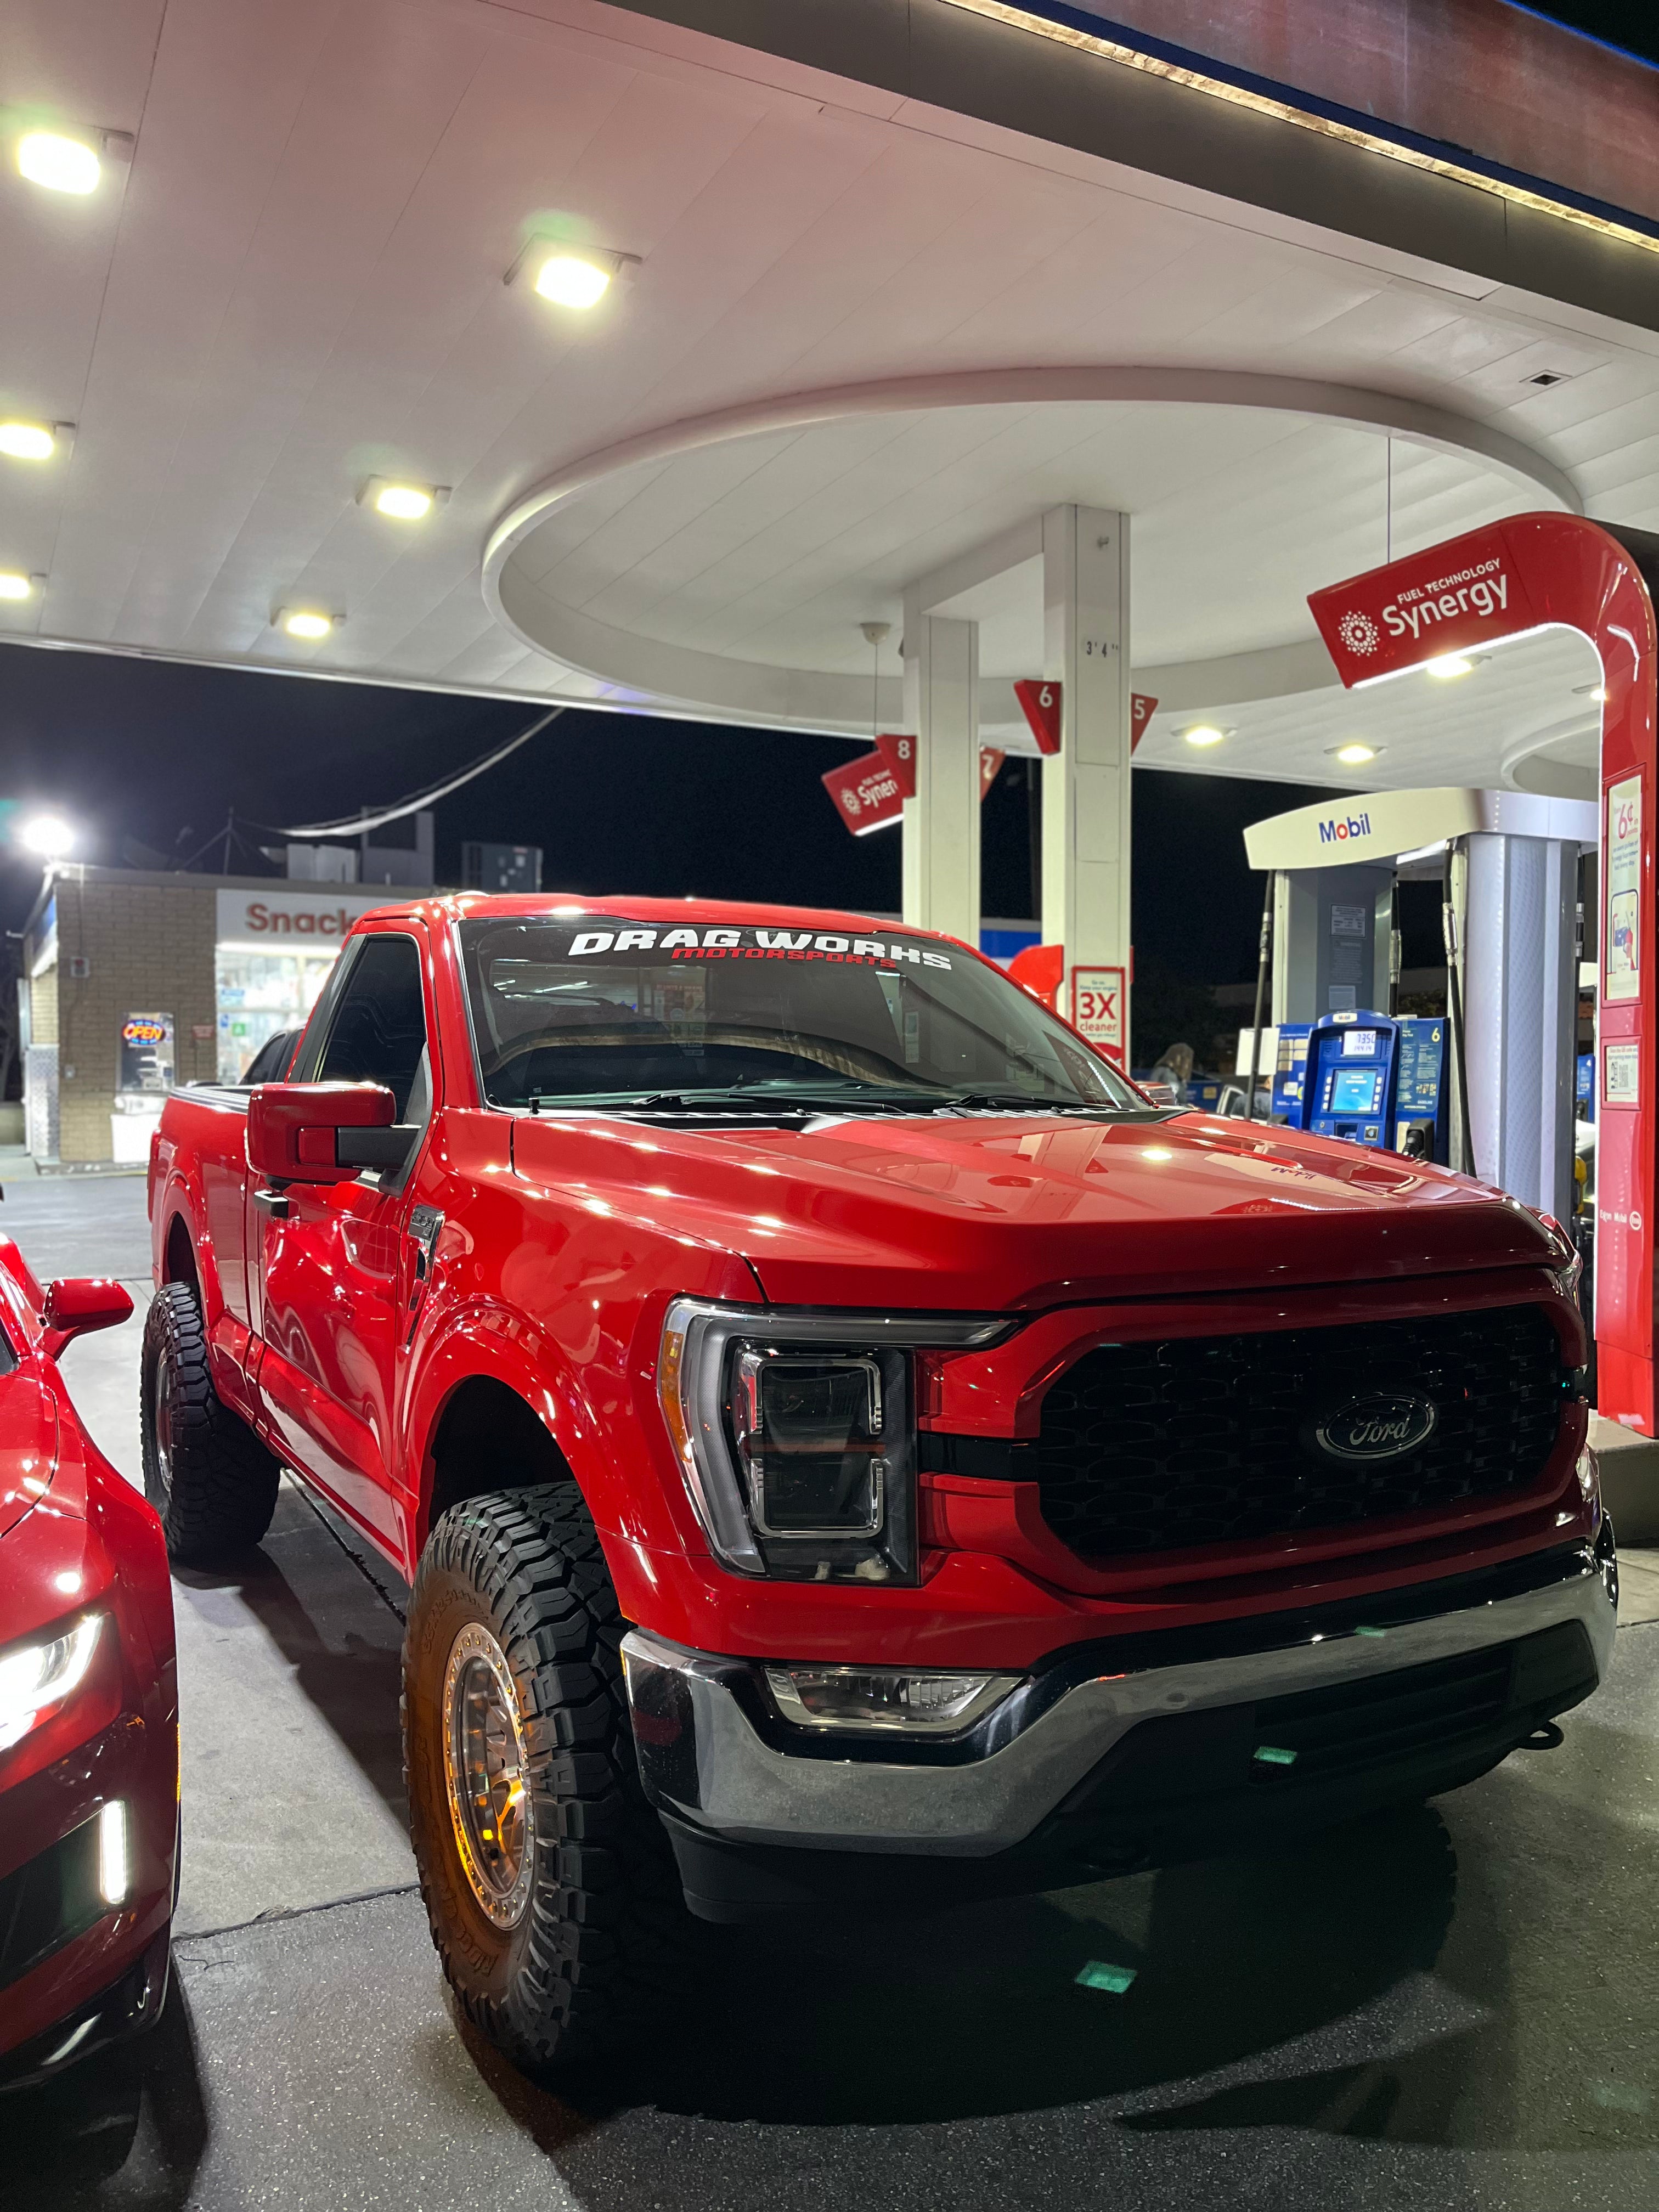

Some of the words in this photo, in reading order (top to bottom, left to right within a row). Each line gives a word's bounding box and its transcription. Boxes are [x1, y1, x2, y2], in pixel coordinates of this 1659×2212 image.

[1397, 588, 1425, 604] FUEL
[1425, 557, 1500, 594] TECHNOLOGY
[1382, 574, 1507, 639] Synergy
[1039, 685, 1053, 708] 6
[1133, 698, 1146, 720] 5
[898, 739, 911, 760] 8
[857, 779, 899, 808] Syner
[1318, 812, 1372, 843] Mobil
[246, 902, 359, 936] Snack
[568, 929, 742, 956] DRAG
[755, 930, 952, 970] WORKS
[671, 947, 897, 969] MOTORSPORTS
[1079, 991, 1118, 1020] 3X
[122, 1025, 163, 1041] OPEN
[1080, 1020, 1118, 1032] cleaner
[1431, 1027, 1441, 1042] 6
[1349, 1410, 1410, 1446] Ford
